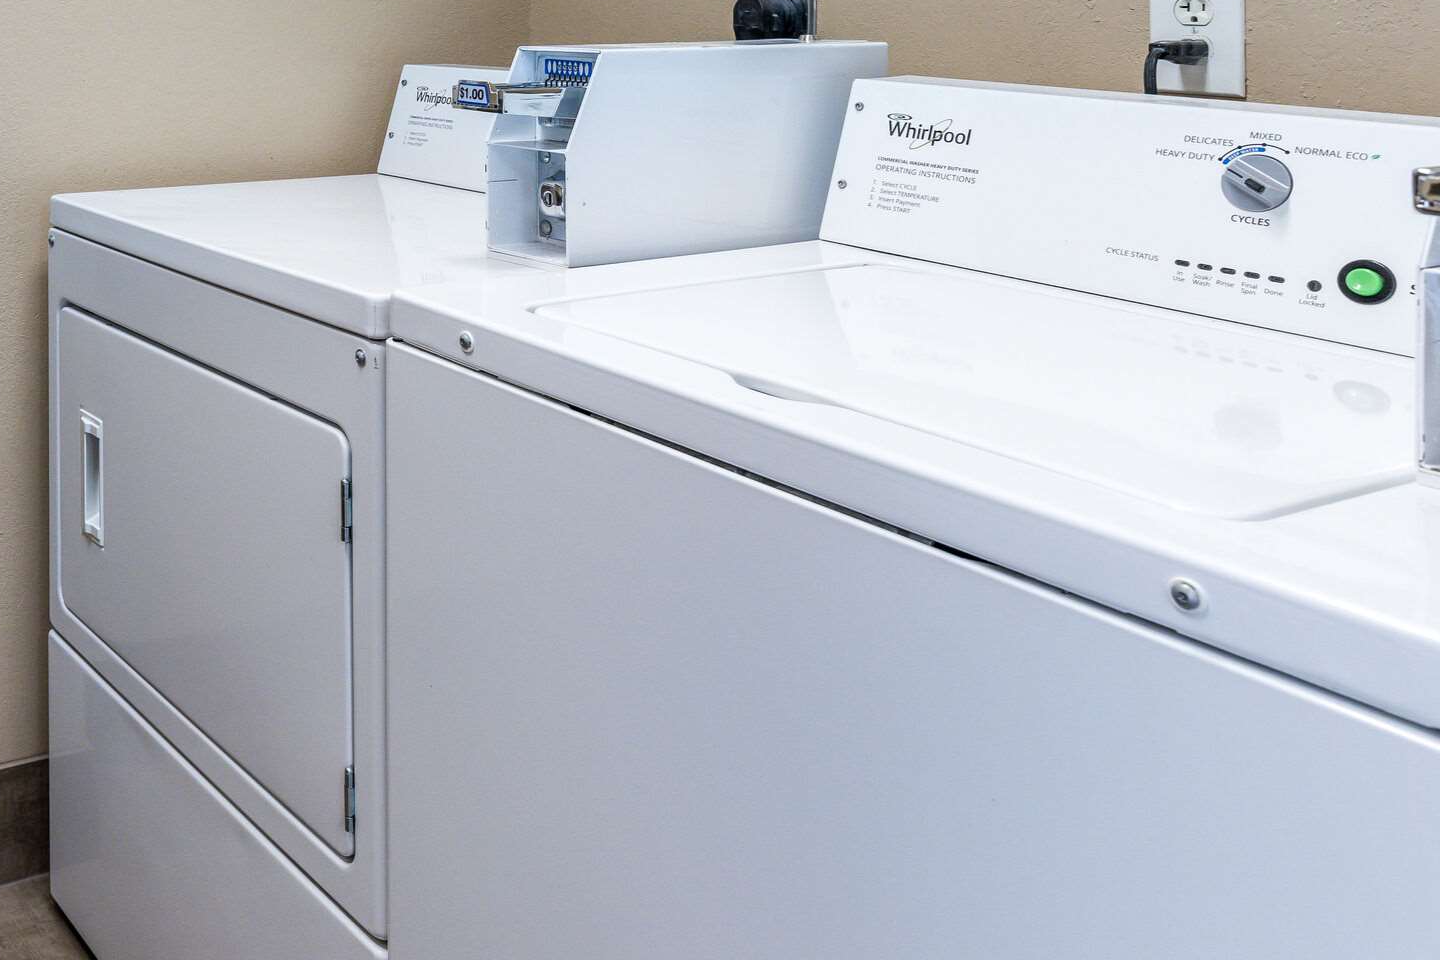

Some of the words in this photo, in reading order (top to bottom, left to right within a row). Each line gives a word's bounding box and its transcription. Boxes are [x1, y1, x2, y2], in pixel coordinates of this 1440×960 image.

[416, 91, 453, 106] Whirlpoo
[460, 86, 484, 100] $1.00
[888, 120, 972, 146] Whirlpool
[1250, 132, 1282, 141] MIXED
[1184, 134, 1234, 146] DELICATES
[878, 156, 908, 164] COMMERCIAL
[1155, 148, 1186, 158] HEAVY
[1188, 152, 1216, 160] DUTY
[1294, 146, 1342, 158] NORMAL
[1346, 152, 1368, 161] ECO
[875, 164, 918, 176] OPERATING
[918, 170, 977, 184] INSTRUCTIONS
[898, 190, 940, 202] TEMPERATURE
[1230, 214, 1271, 227] CYCLES
[1105, 246, 1129, 256] CYCLE
[1130, 251, 1160, 261] STATUS
